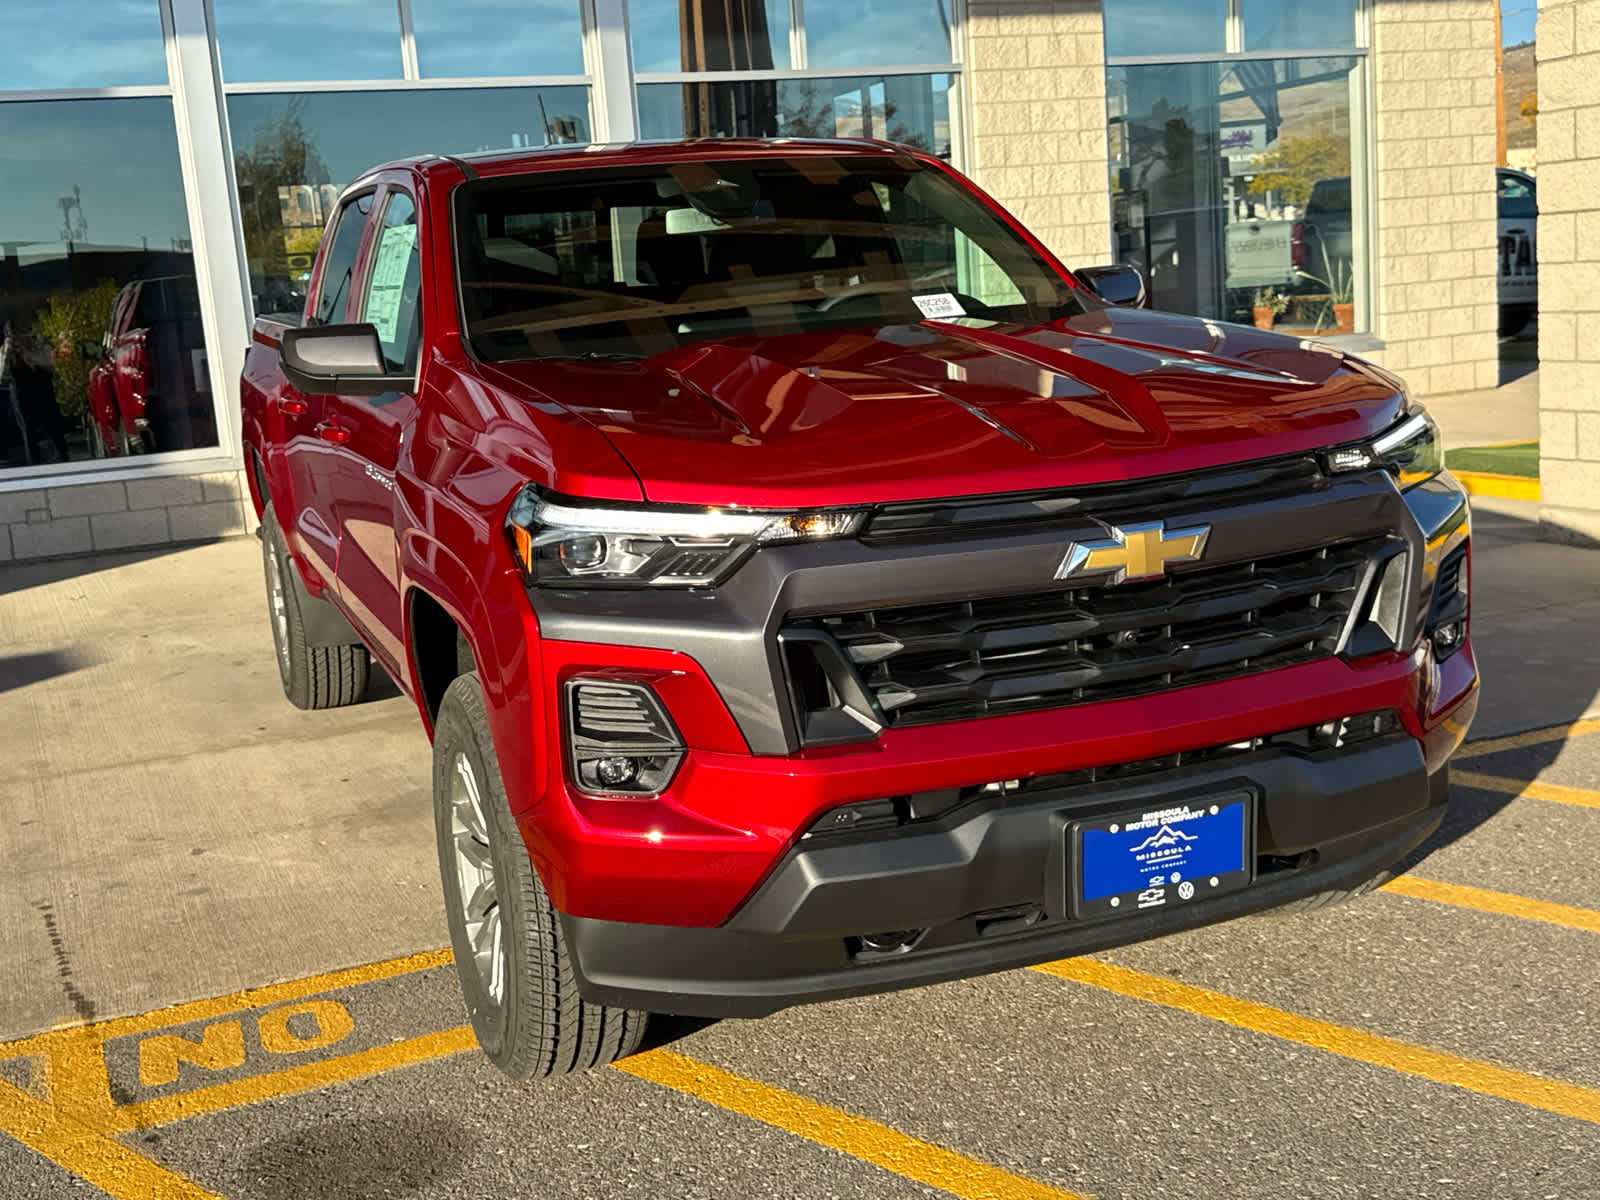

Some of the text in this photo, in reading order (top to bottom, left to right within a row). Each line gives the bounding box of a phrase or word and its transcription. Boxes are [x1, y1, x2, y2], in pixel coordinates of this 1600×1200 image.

[1125, 809, 1205, 832] MOTOR COMPANY
[1142, 806, 1190, 821] MISSOULA
[1136, 845, 1192, 861] MISSOULA
[139, 1000, 355, 1087] NO
